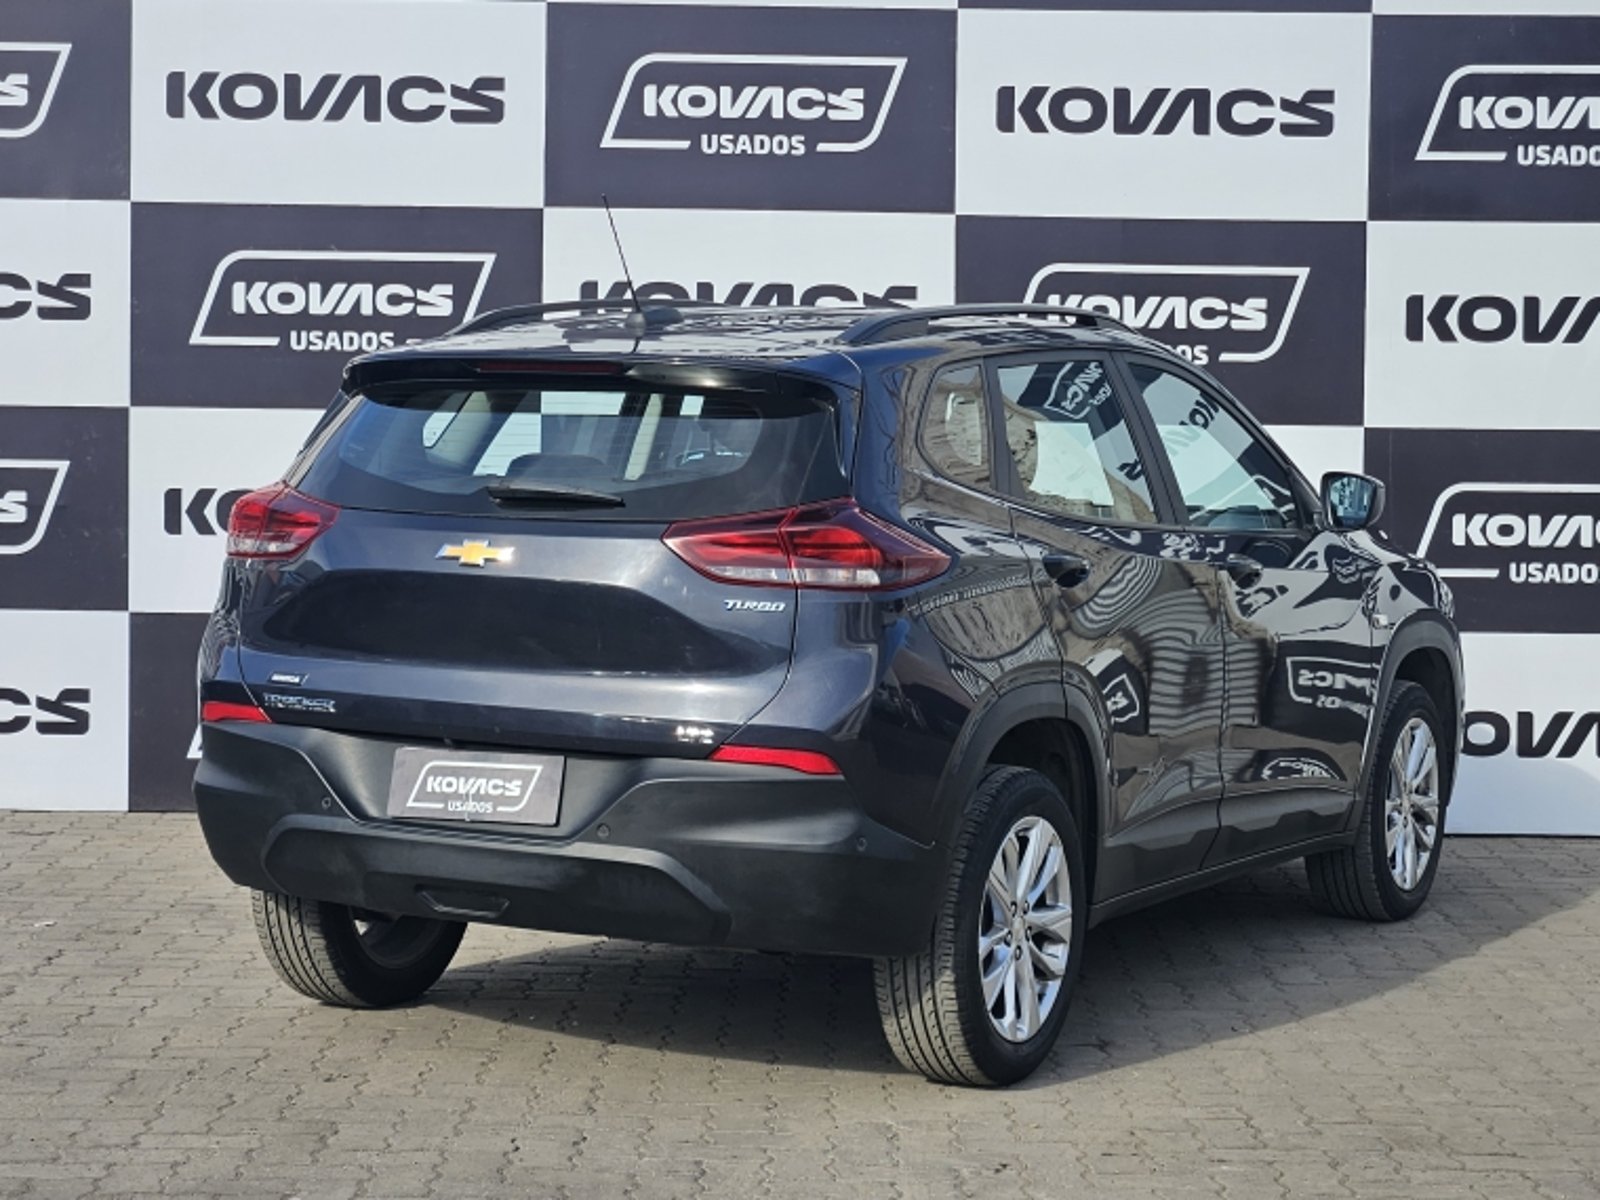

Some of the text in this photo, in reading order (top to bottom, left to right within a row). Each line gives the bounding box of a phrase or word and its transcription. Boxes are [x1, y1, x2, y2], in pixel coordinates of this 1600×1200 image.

[166, 72, 505, 125] KOVACS
[644, 84, 864, 121] KOVACS
[997, 86, 1335, 137] KOVACS
[701, 134, 806, 156] USADOS
[232, 281, 453, 317] KOVACS
[290, 330, 394, 352] USADOS
[1452, 513, 1600, 548] KOVA
[1509, 562, 1600, 584] USADO
[1463, 711, 1600, 758] OVA
[427, 776, 522, 797] KOVACS
